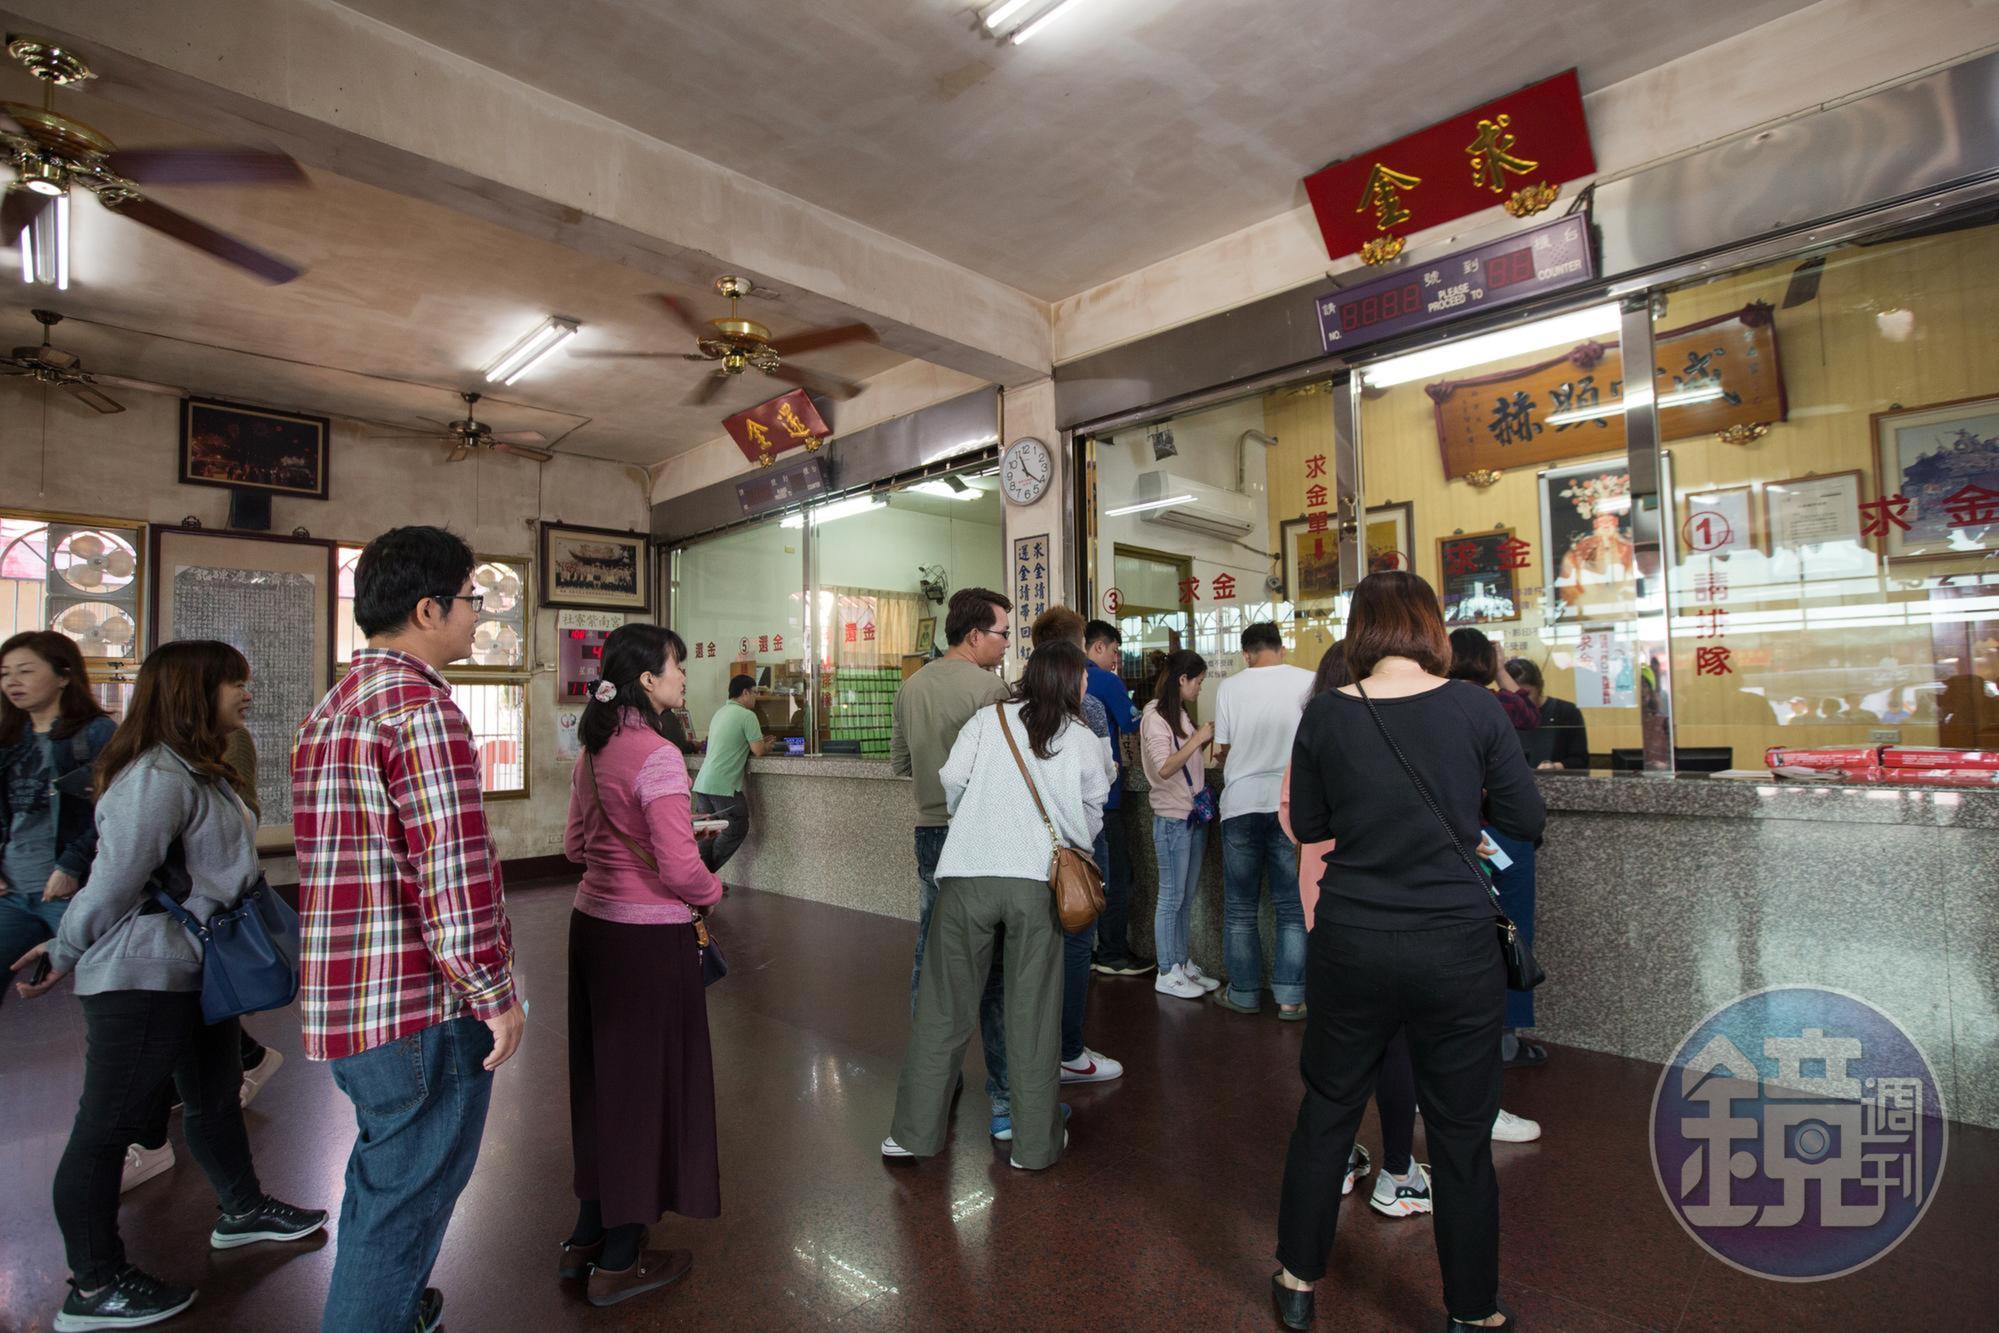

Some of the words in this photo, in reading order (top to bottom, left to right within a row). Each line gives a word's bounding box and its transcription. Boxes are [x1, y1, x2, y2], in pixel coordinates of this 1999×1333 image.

[1356, 114, 1538, 231] 求金
[1537, 260, 1583, 281] COUNTER
[1427, 294, 1466, 314] PROCEED
[1470, 287, 1483, 300] TO
[1438, 282, 1471, 300] PLEASE
[1305, 454, 1328, 535] 求金單
[1858, 483, 1999, 537] 求金
[1446, 537, 1532, 575] 求金
[1178, 572, 1237, 604] 求金
